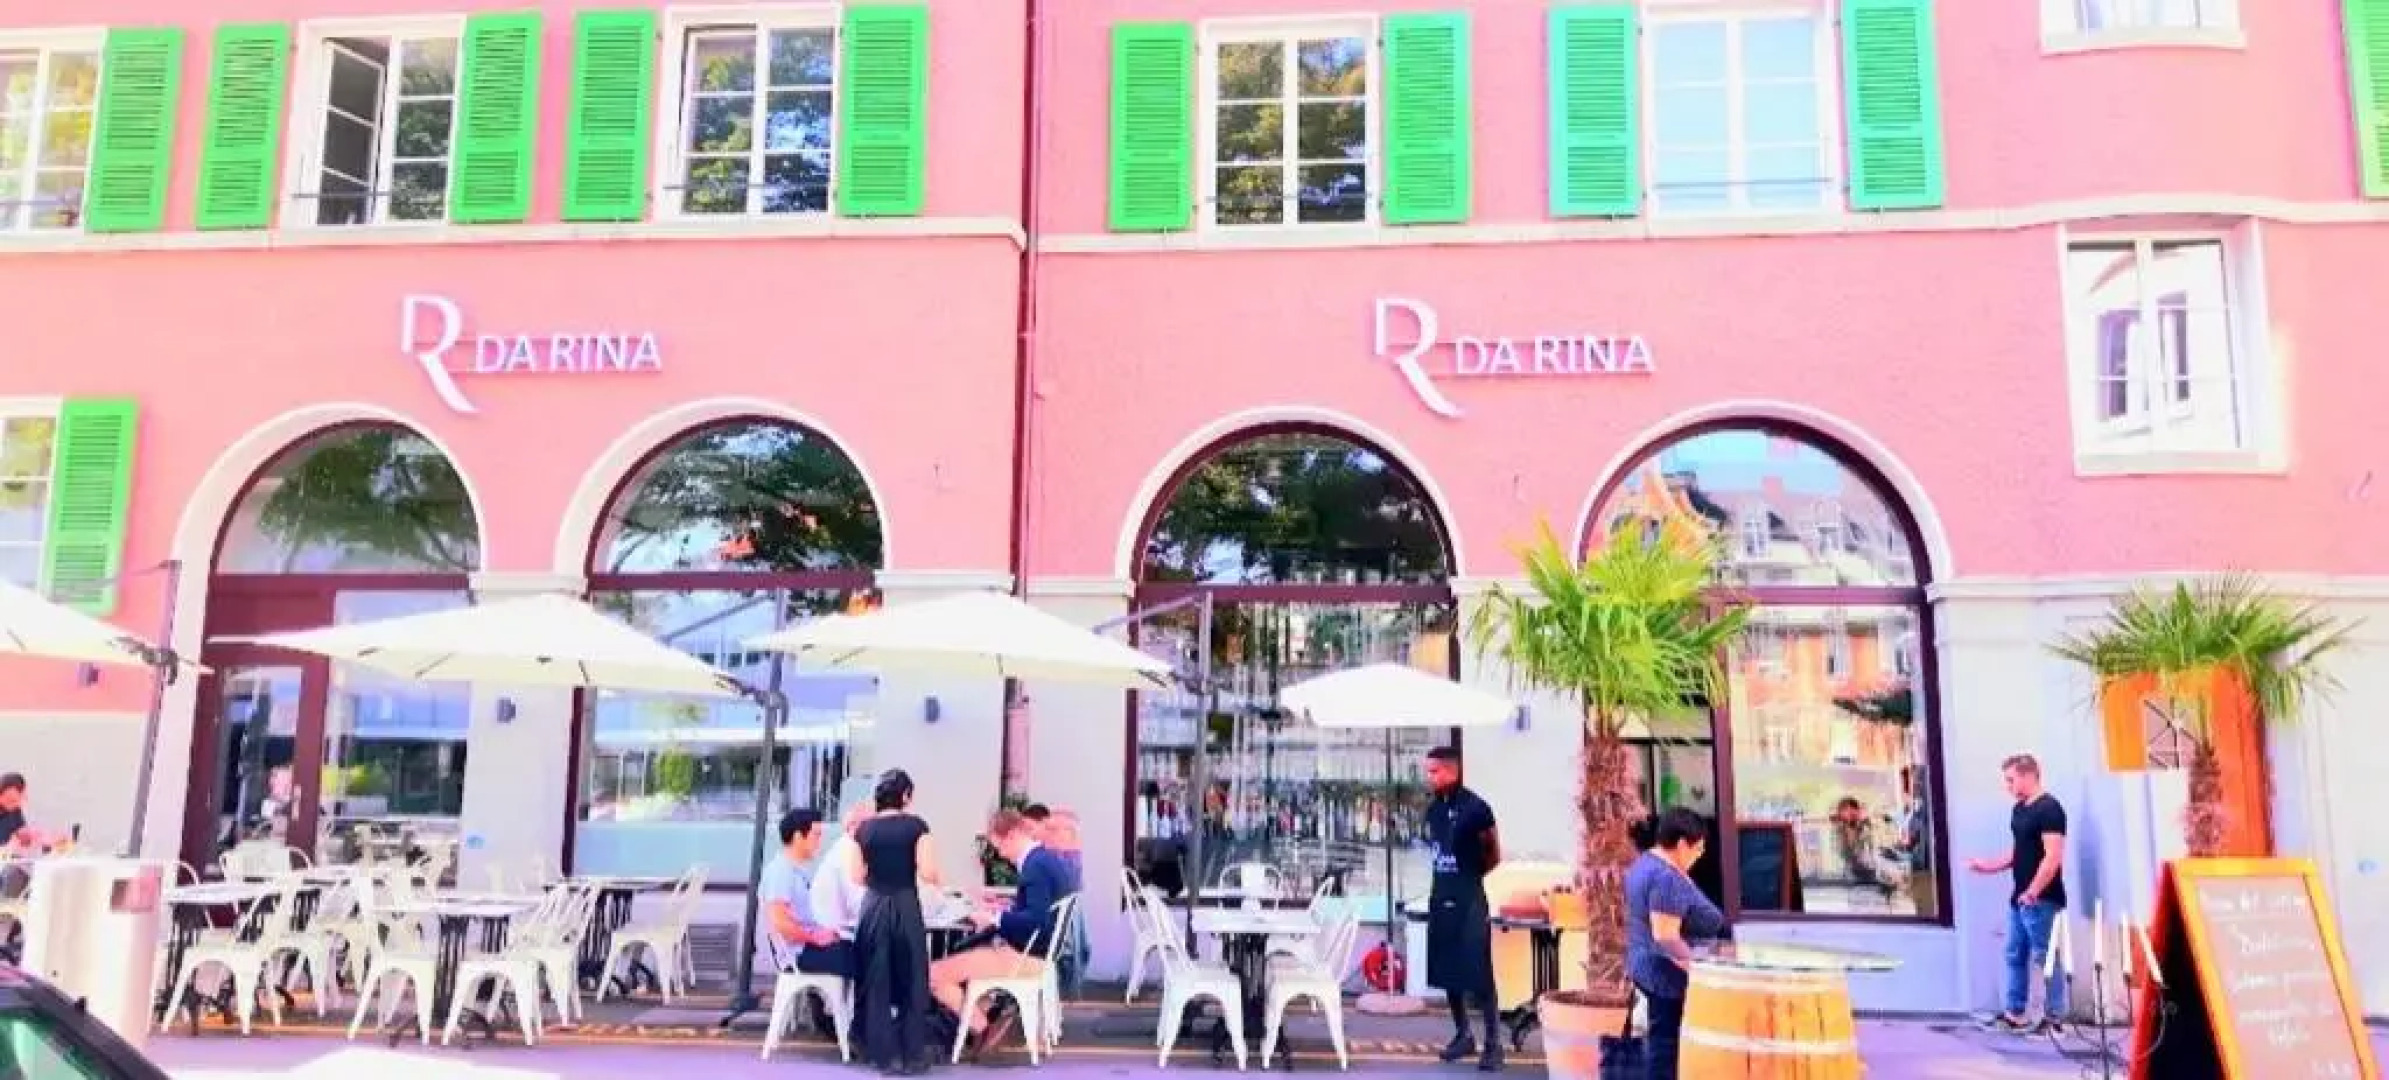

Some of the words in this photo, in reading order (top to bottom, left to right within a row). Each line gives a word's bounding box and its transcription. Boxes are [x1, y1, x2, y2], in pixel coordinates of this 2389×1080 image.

[402, 294, 478, 413] R
[475, 334, 536, 373] DA
[550, 332, 662, 372] RINA
[1375, 298, 1462, 417] R
[1456, 336, 1521, 374] DA
[1534, 334, 1656, 373] RINA
